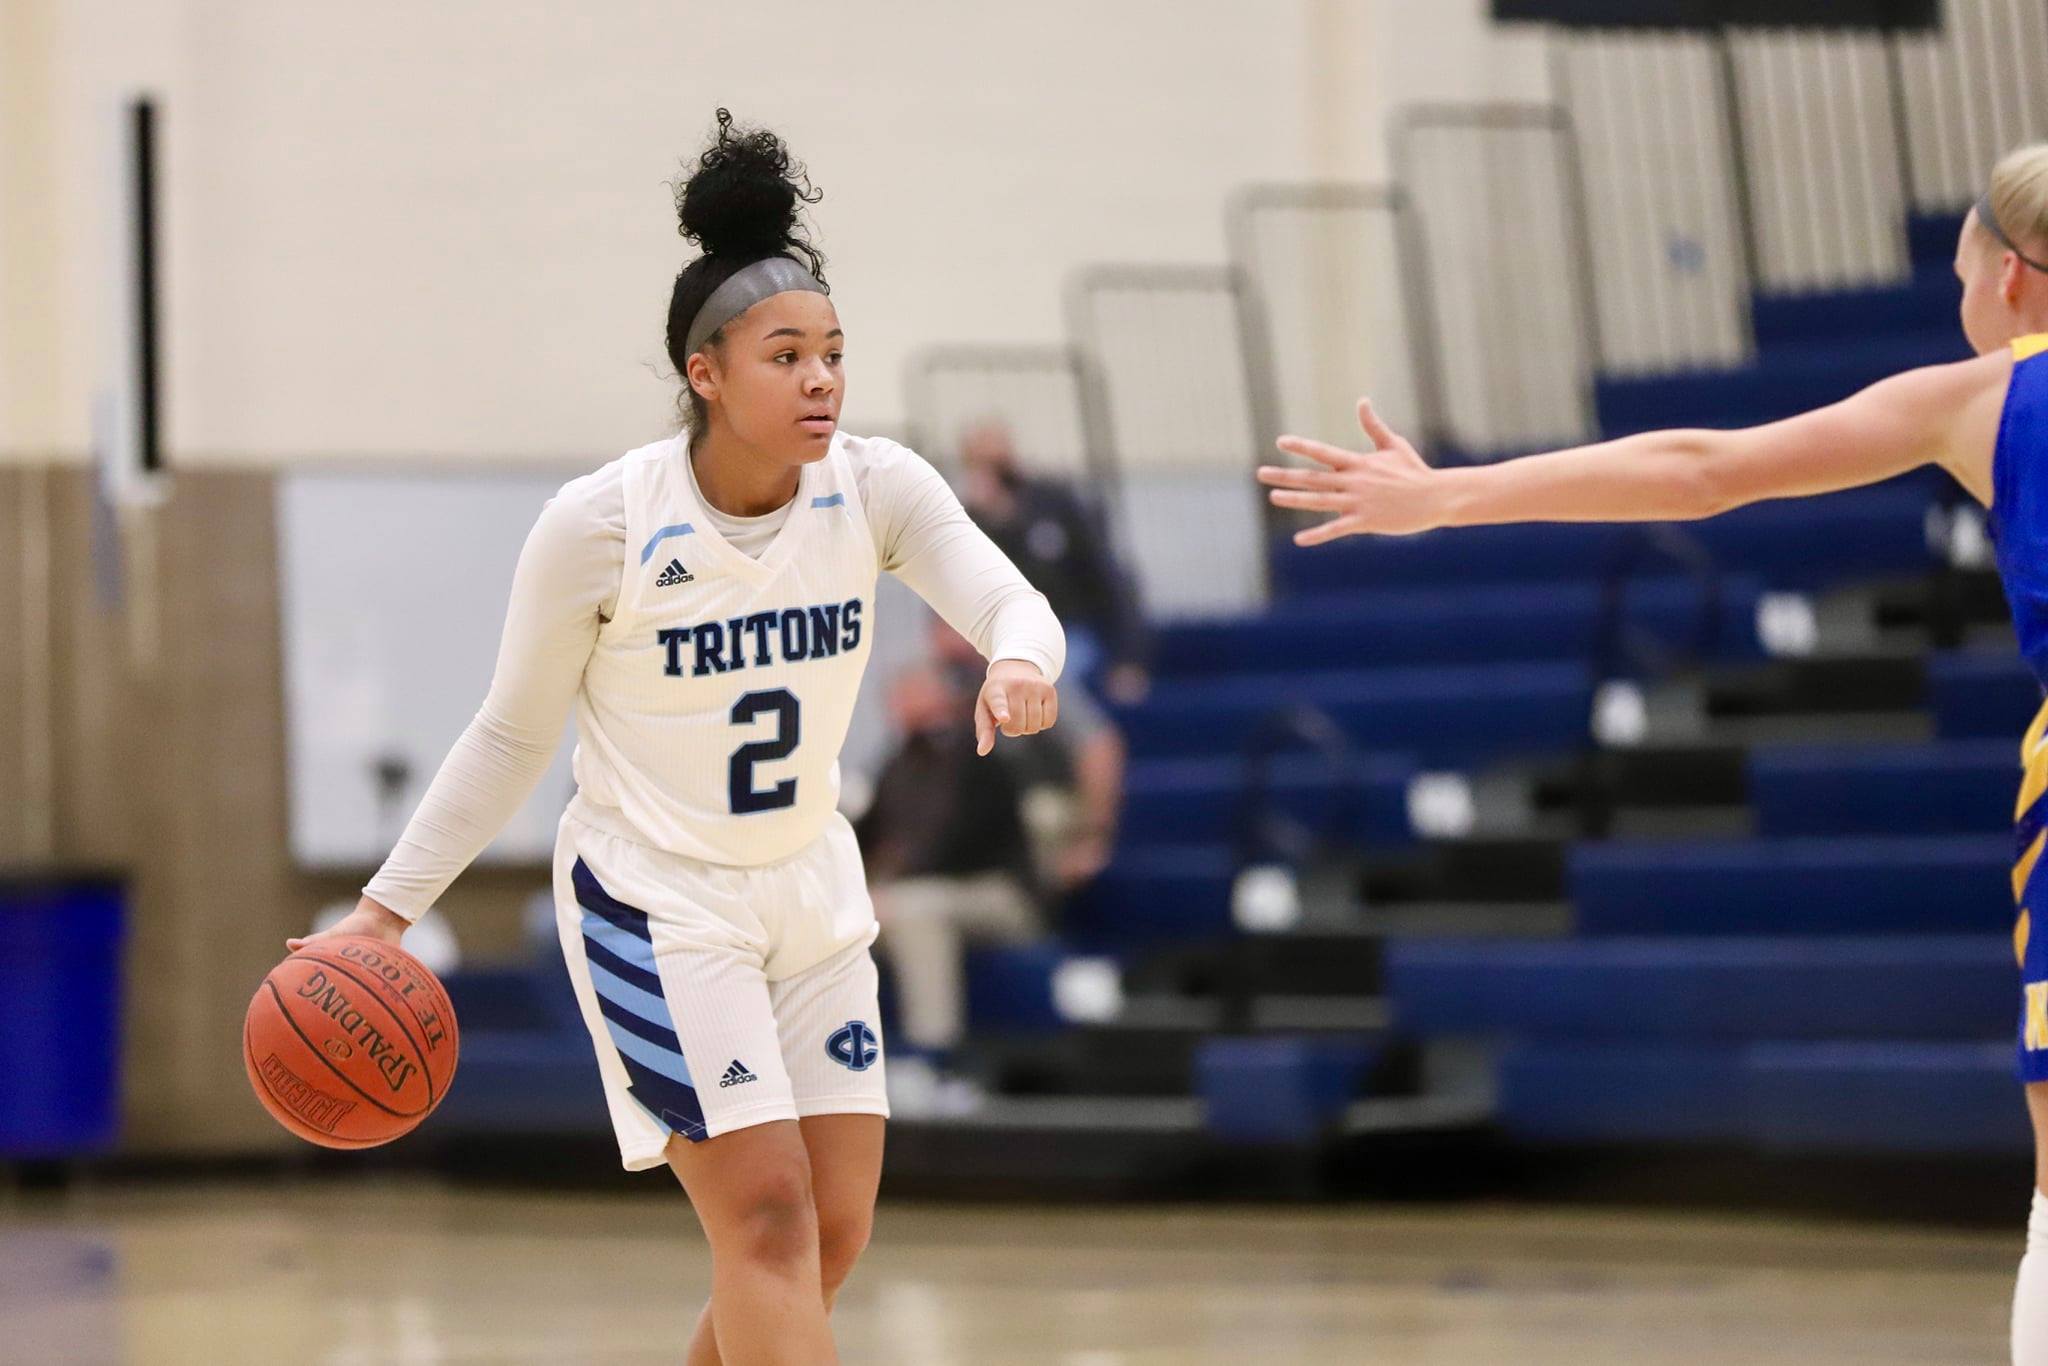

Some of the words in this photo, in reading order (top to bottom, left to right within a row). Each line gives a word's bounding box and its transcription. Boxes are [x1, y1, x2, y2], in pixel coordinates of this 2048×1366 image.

[656, 573, 695, 587] adidas
[656, 597, 864, 678] TRITONS
[728, 686, 801, 816] 2
[297, 970, 418, 1093] SPALDING
[719, 1073, 758, 1089] adidas
